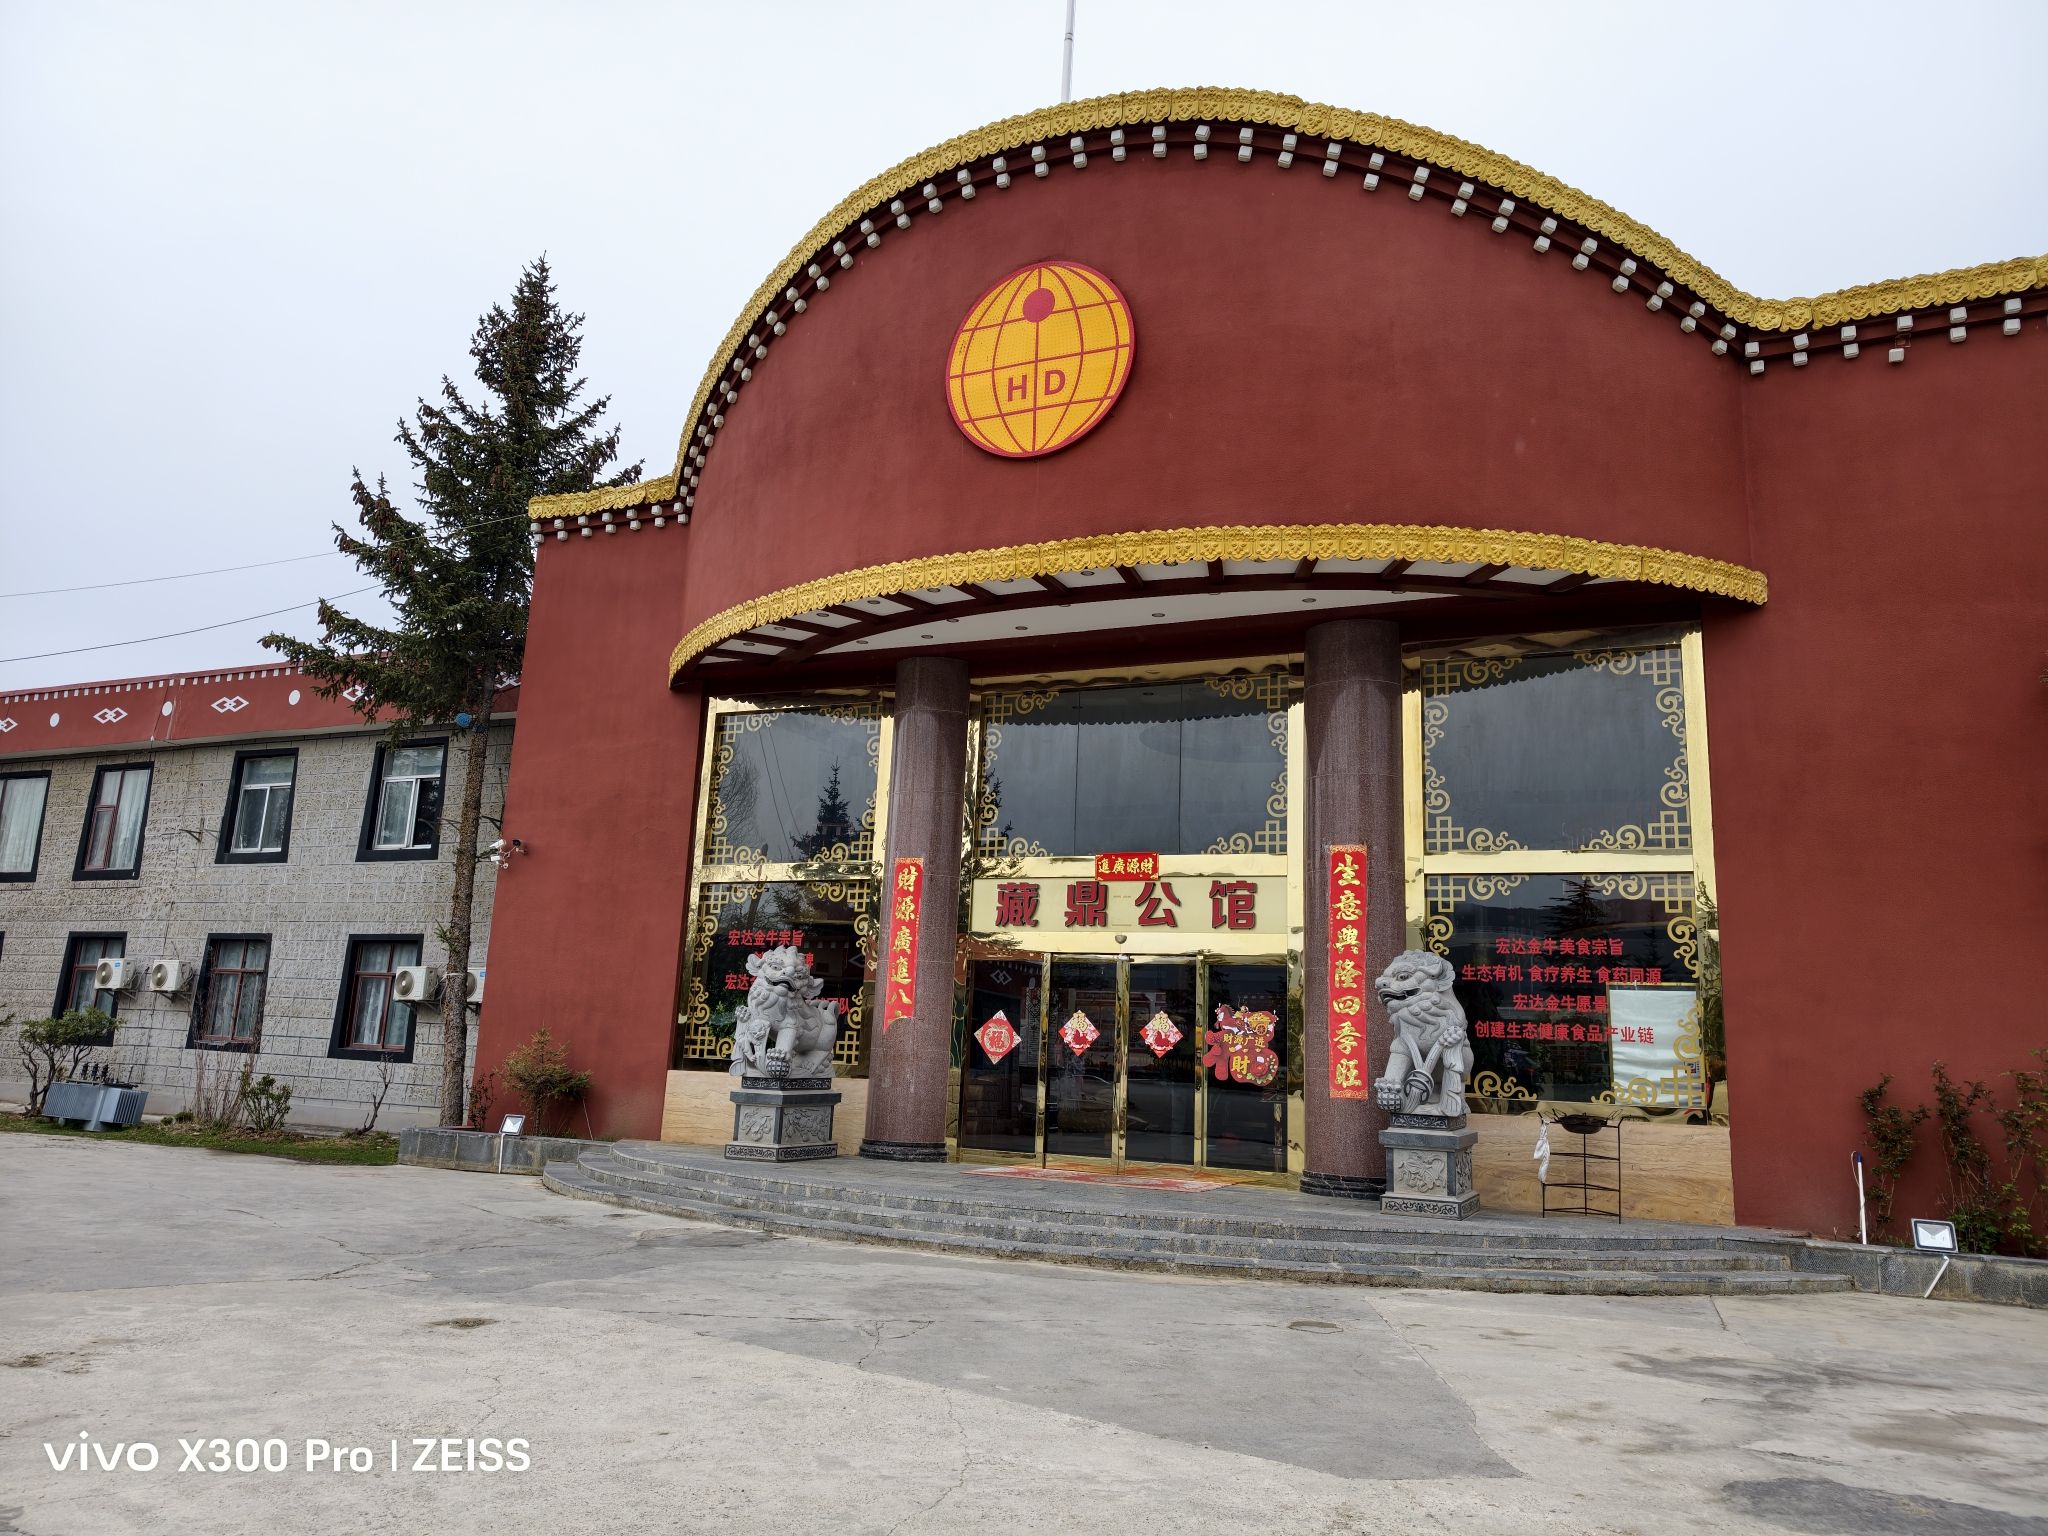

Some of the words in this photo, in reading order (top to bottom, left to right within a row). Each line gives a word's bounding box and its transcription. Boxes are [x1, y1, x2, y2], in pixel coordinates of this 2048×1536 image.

[1007, 369, 1067, 402] HD
[995, 880, 1258, 930] 藏鼎公馆
[727, 929, 804, 947] 宏达金牛宗旨
[1495, 938, 1624, 956] 宏达金牛美食宗旨
[1461, 964, 1523, 982] 生态有机
[1528, 965, 1593, 984] 食疗养生
[1598, 967, 1663, 985] 食药同源
[1512, 994, 1609, 1013] 宏达金牛愿景
[1474, 1020, 1654, 1044] 创建生态健康食品产业链
